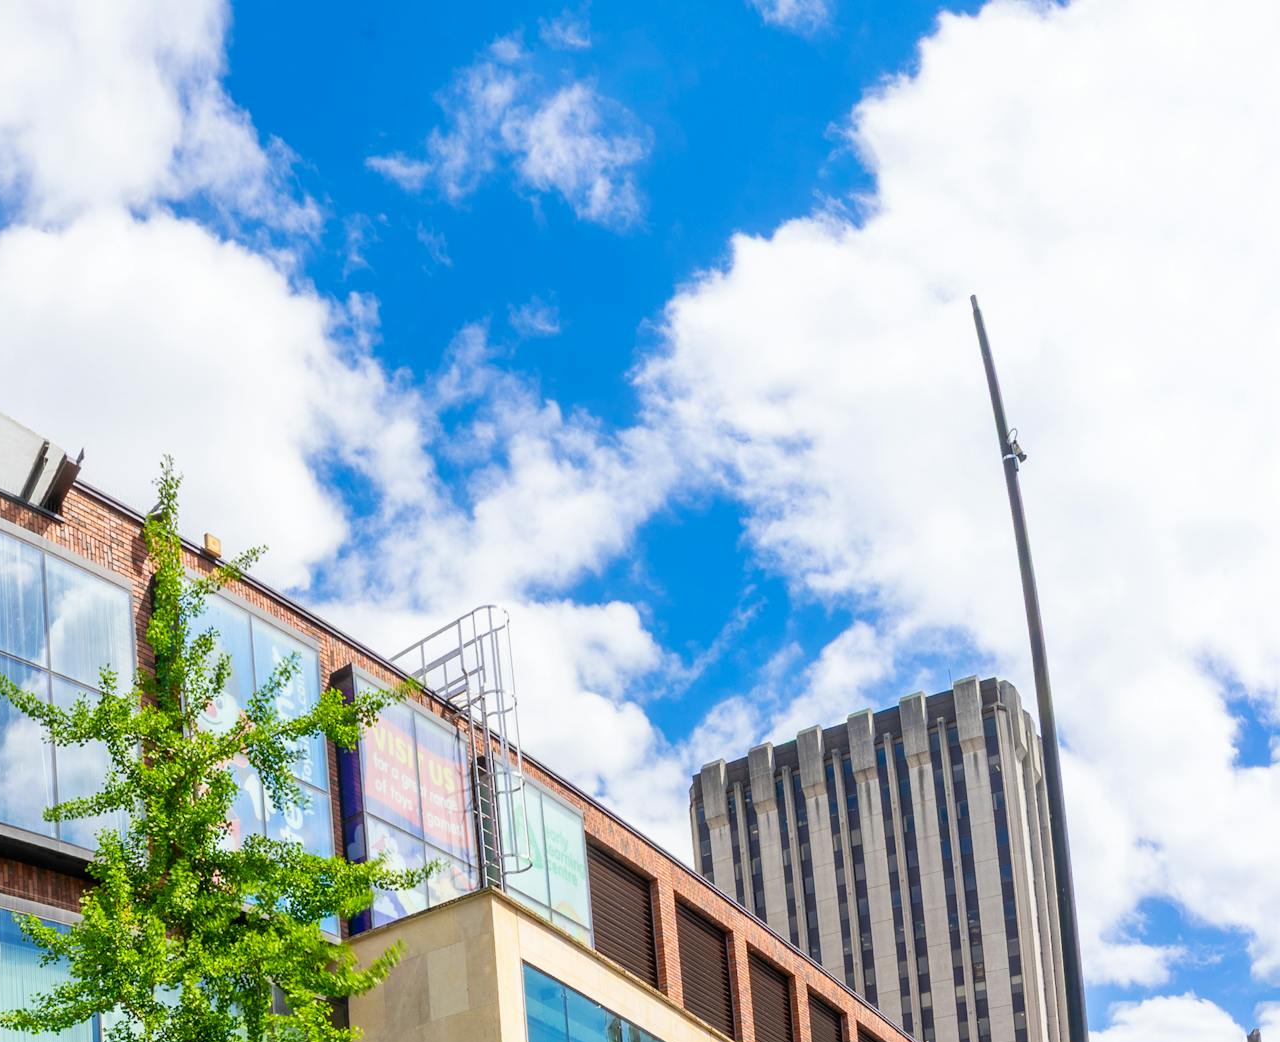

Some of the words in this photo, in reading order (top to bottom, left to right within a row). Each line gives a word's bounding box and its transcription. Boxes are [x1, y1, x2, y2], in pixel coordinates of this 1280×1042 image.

[373, 751, 389, 772] for
[374, 725, 423, 770] VISIT
[428, 758, 456, 794] US
[374, 777, 387, 794] of
[390, 787, 414, 812] toys
